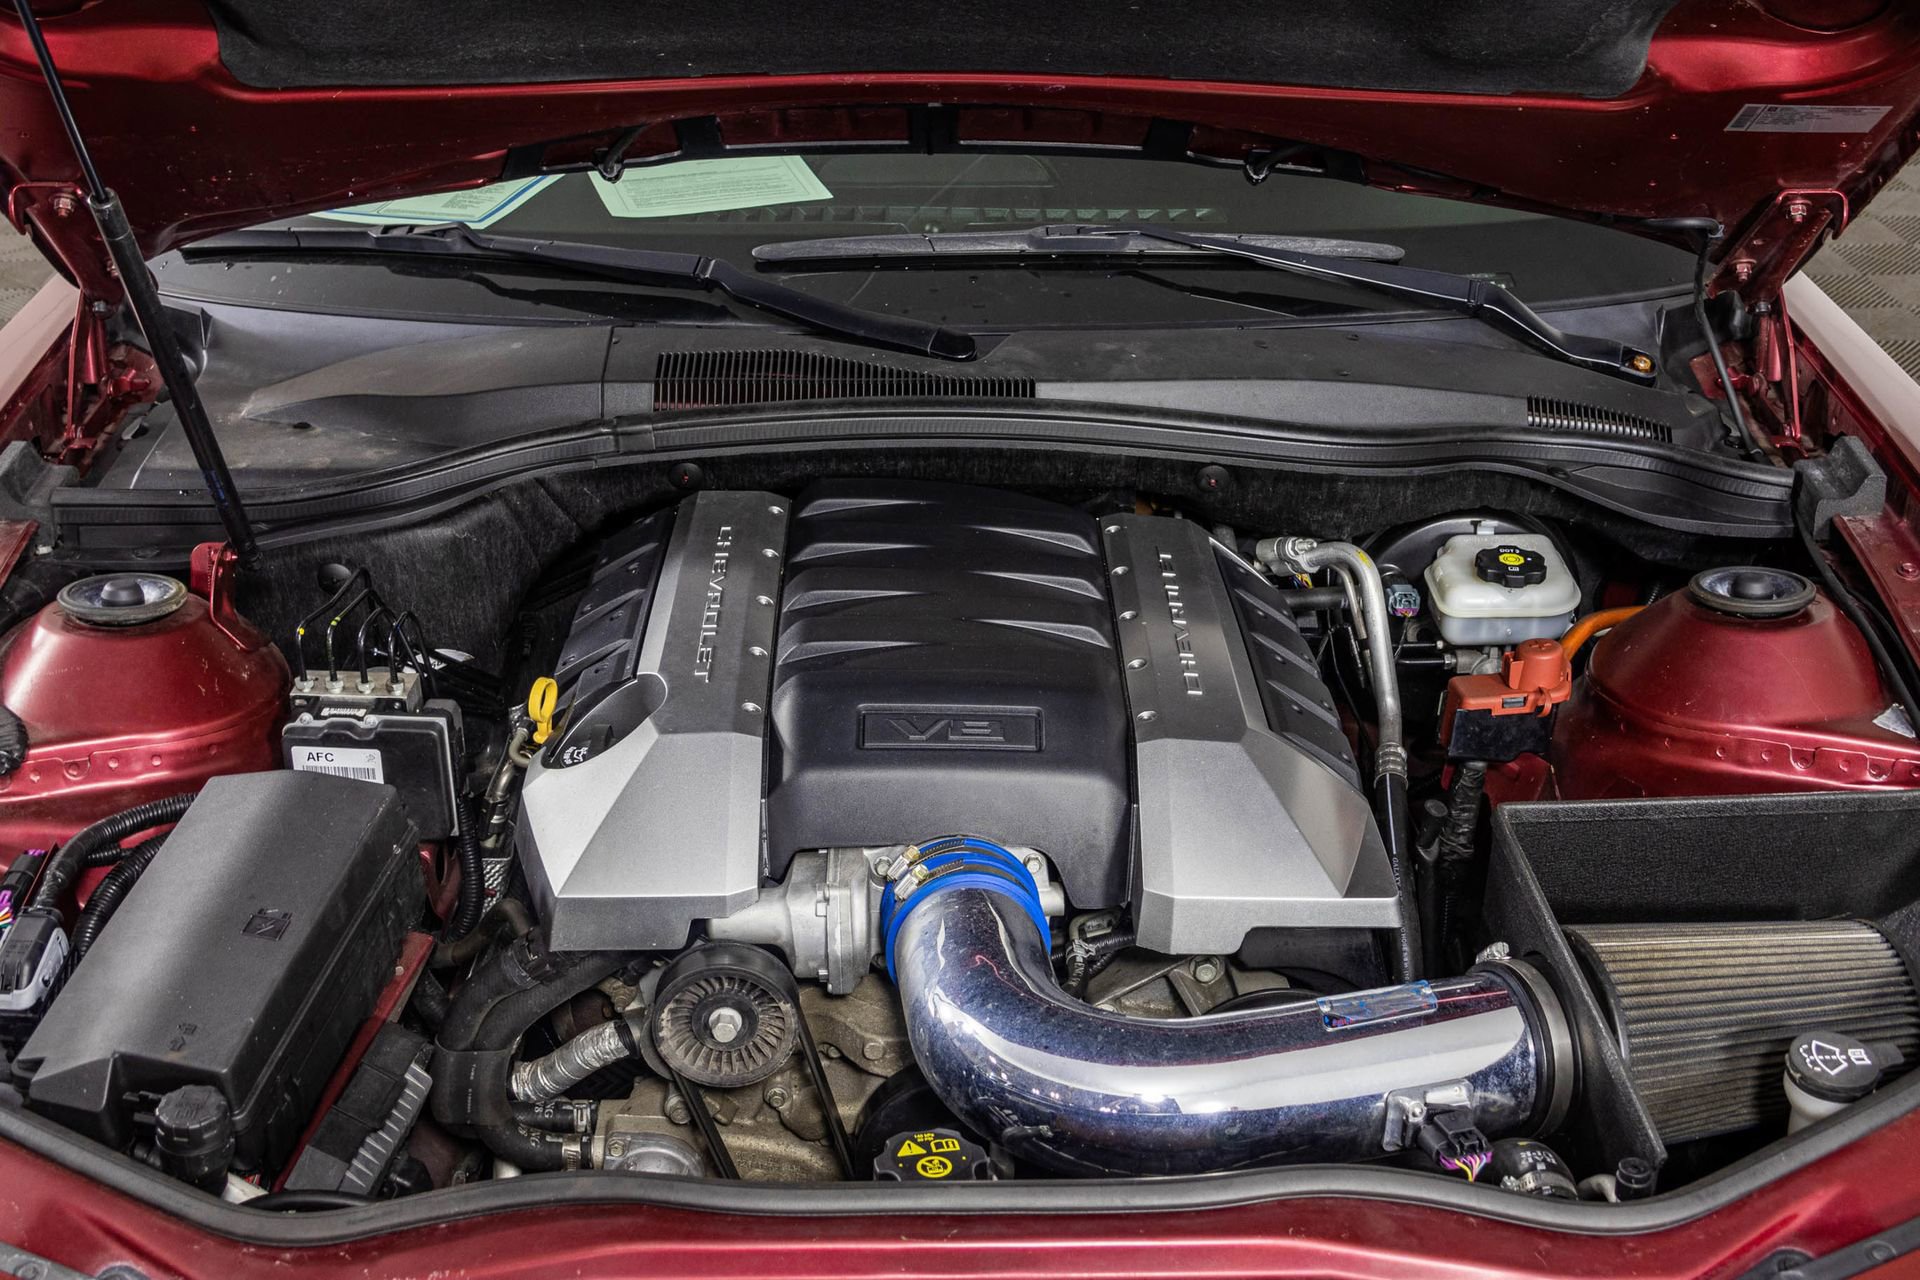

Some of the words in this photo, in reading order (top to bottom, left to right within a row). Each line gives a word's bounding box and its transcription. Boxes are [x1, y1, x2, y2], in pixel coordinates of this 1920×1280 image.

[694, 526, 732, 684] CHEVROLET
[1155, 545, 1204, 696] CHEVROLET
[307, 752, 335, 762] AFC
